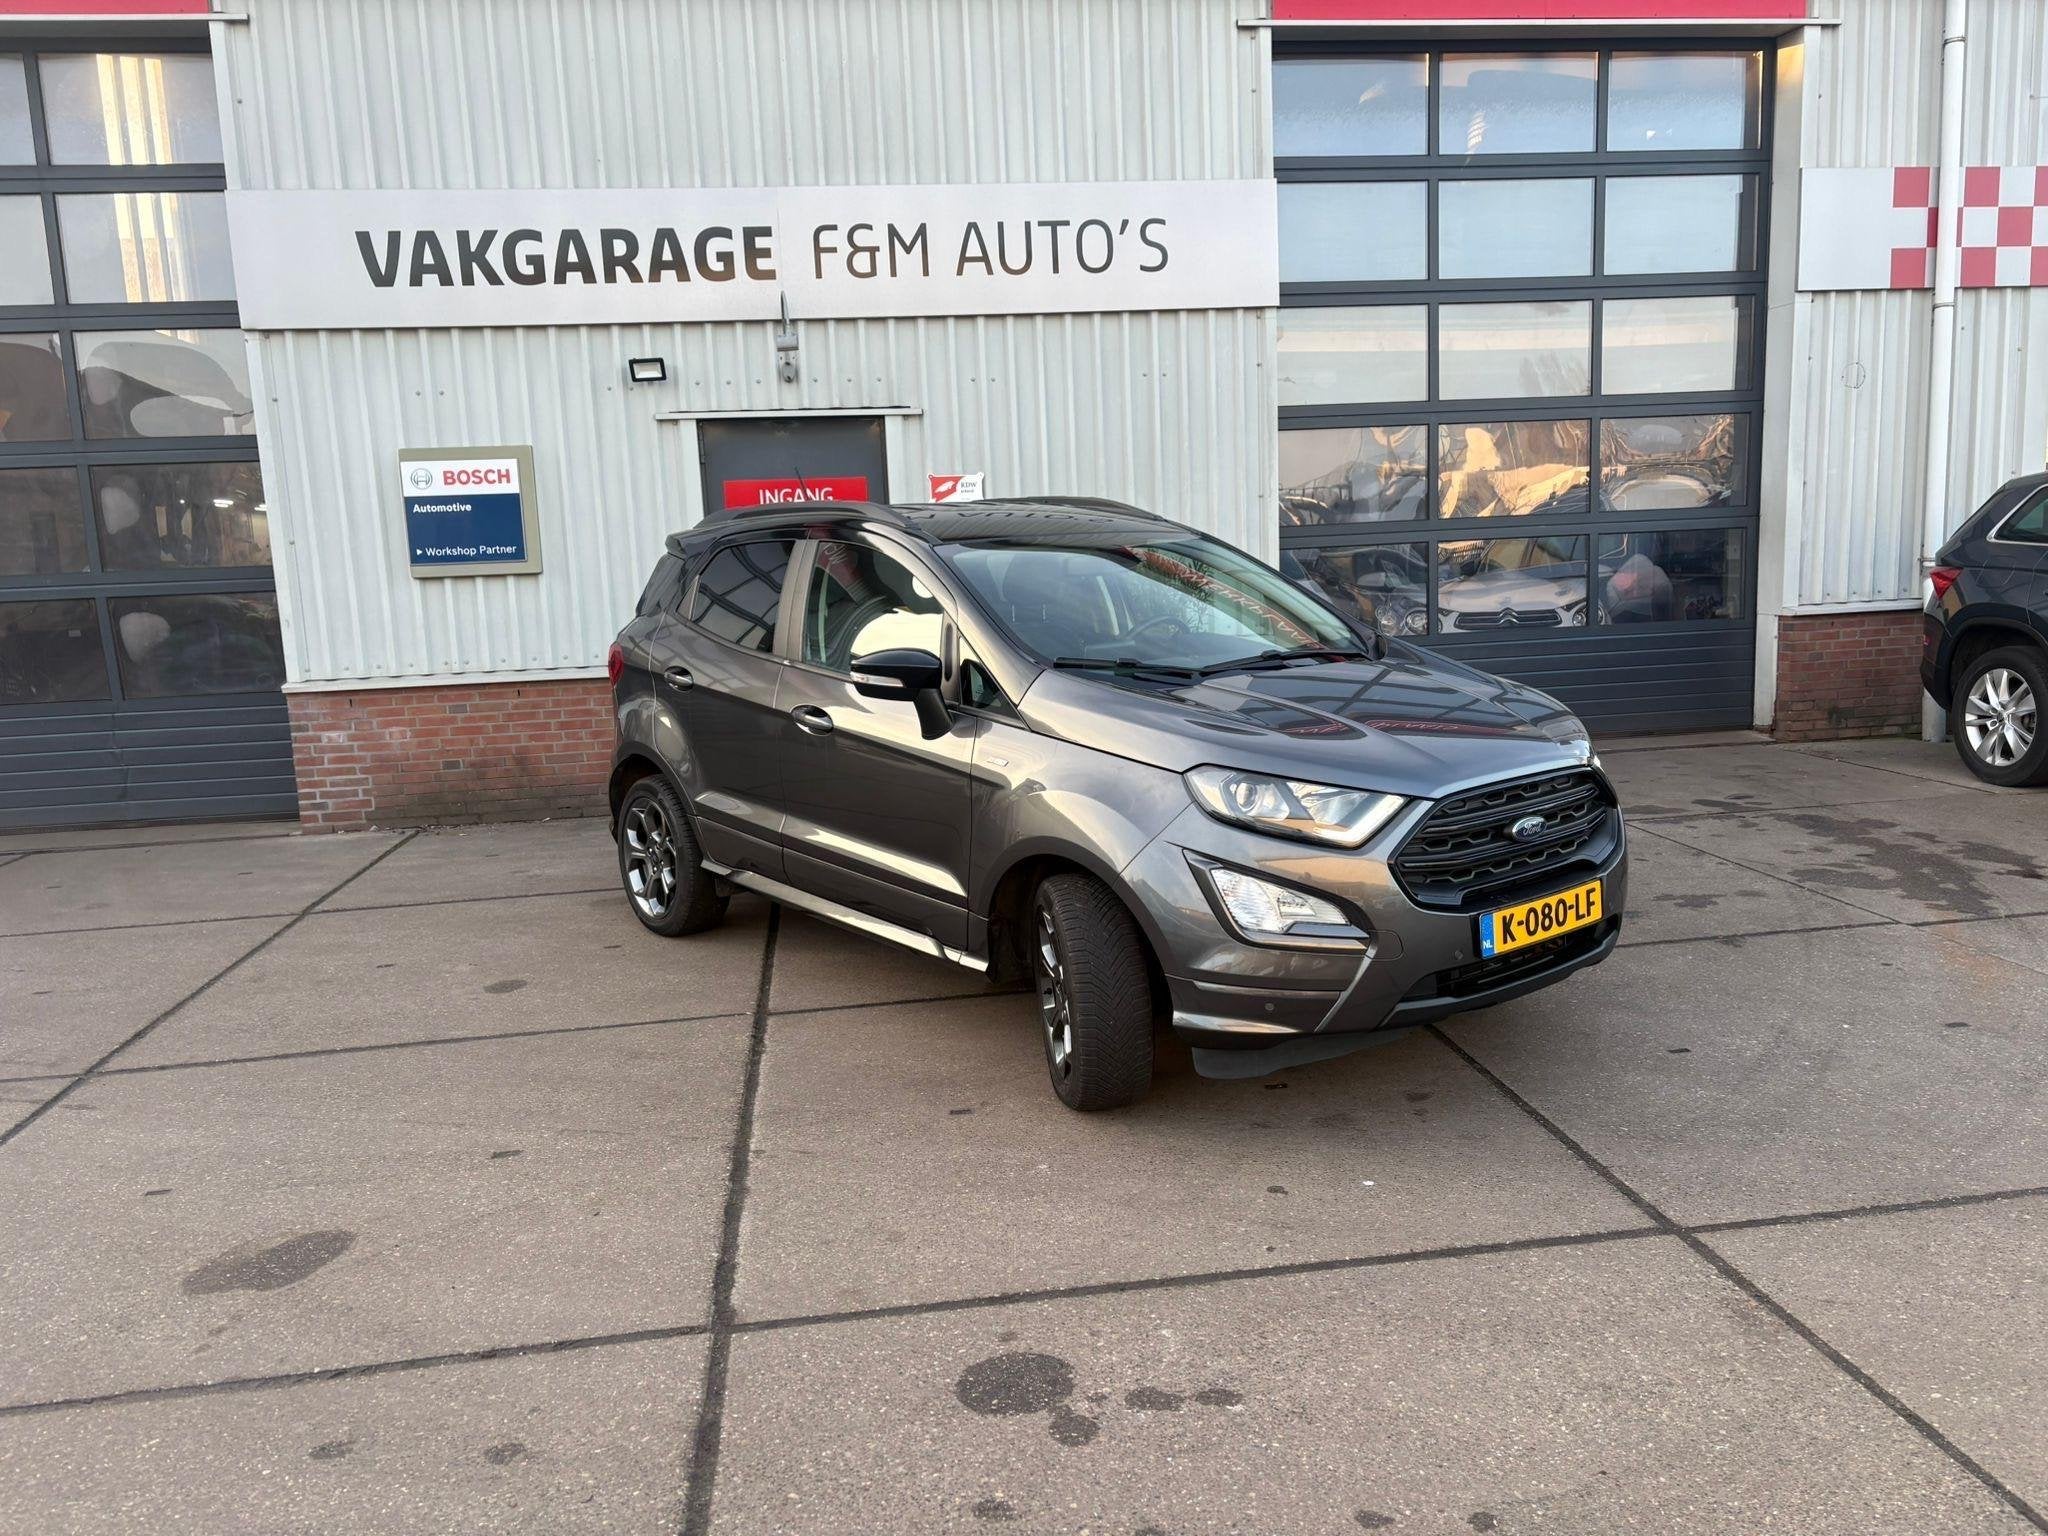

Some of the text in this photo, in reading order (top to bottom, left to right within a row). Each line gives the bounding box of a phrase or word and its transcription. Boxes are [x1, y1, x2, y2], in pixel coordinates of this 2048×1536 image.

[354, 217, 1169, 288] VAKGARAGE F&M AUTO'S
[442, 468, 511, 486] BOSCH
[758, 486, 833, 505] INGANG
[412, 502, 472, 514] Automotive
[425, 545, 517, 557] Workshop Partner
[1522, 820, 1543, 836] Ford
[1502, 887, 1596, 945] K-080-LF
[1482, 940, 1493, 949] NL
